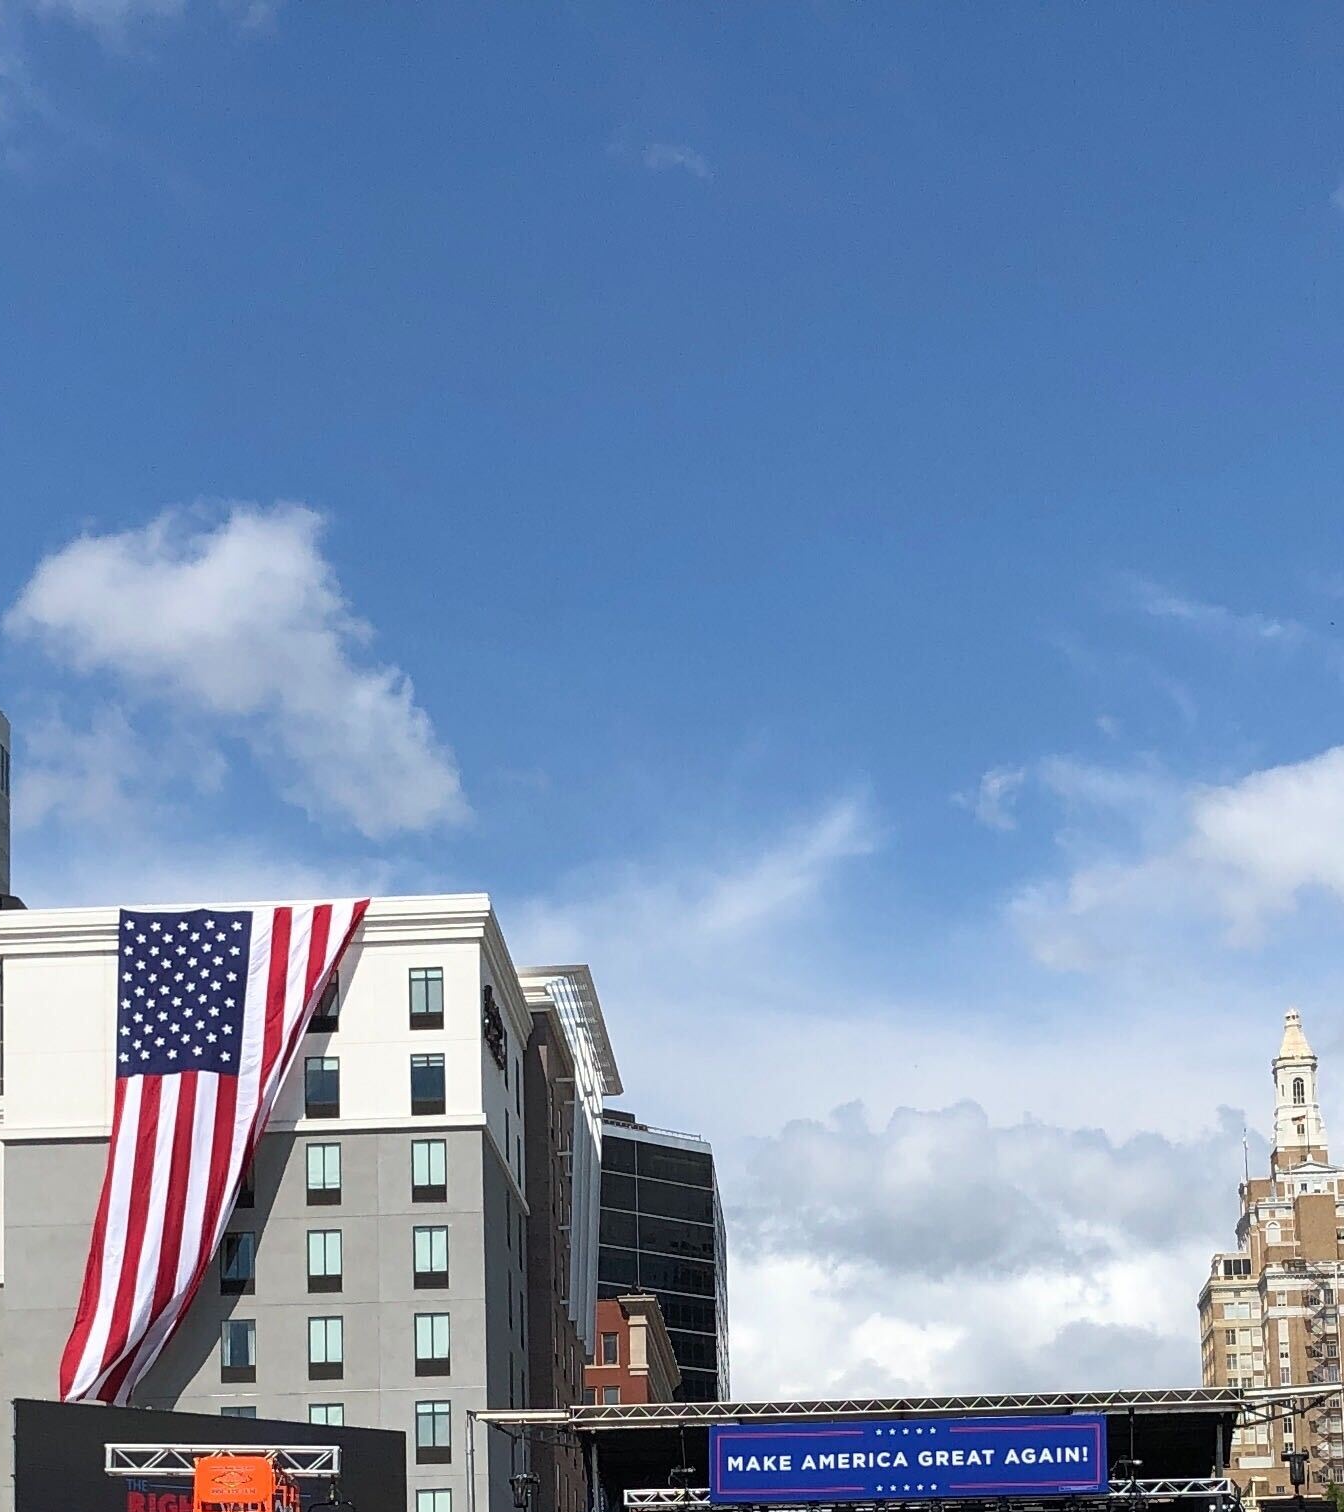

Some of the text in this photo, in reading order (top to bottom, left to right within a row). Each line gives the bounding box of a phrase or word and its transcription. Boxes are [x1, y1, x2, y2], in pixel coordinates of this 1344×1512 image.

[726, 1446, 1089, 1473] MAKE AMERICA GREAT AGAIN!
[126, 1478, 149, 1492] THE
